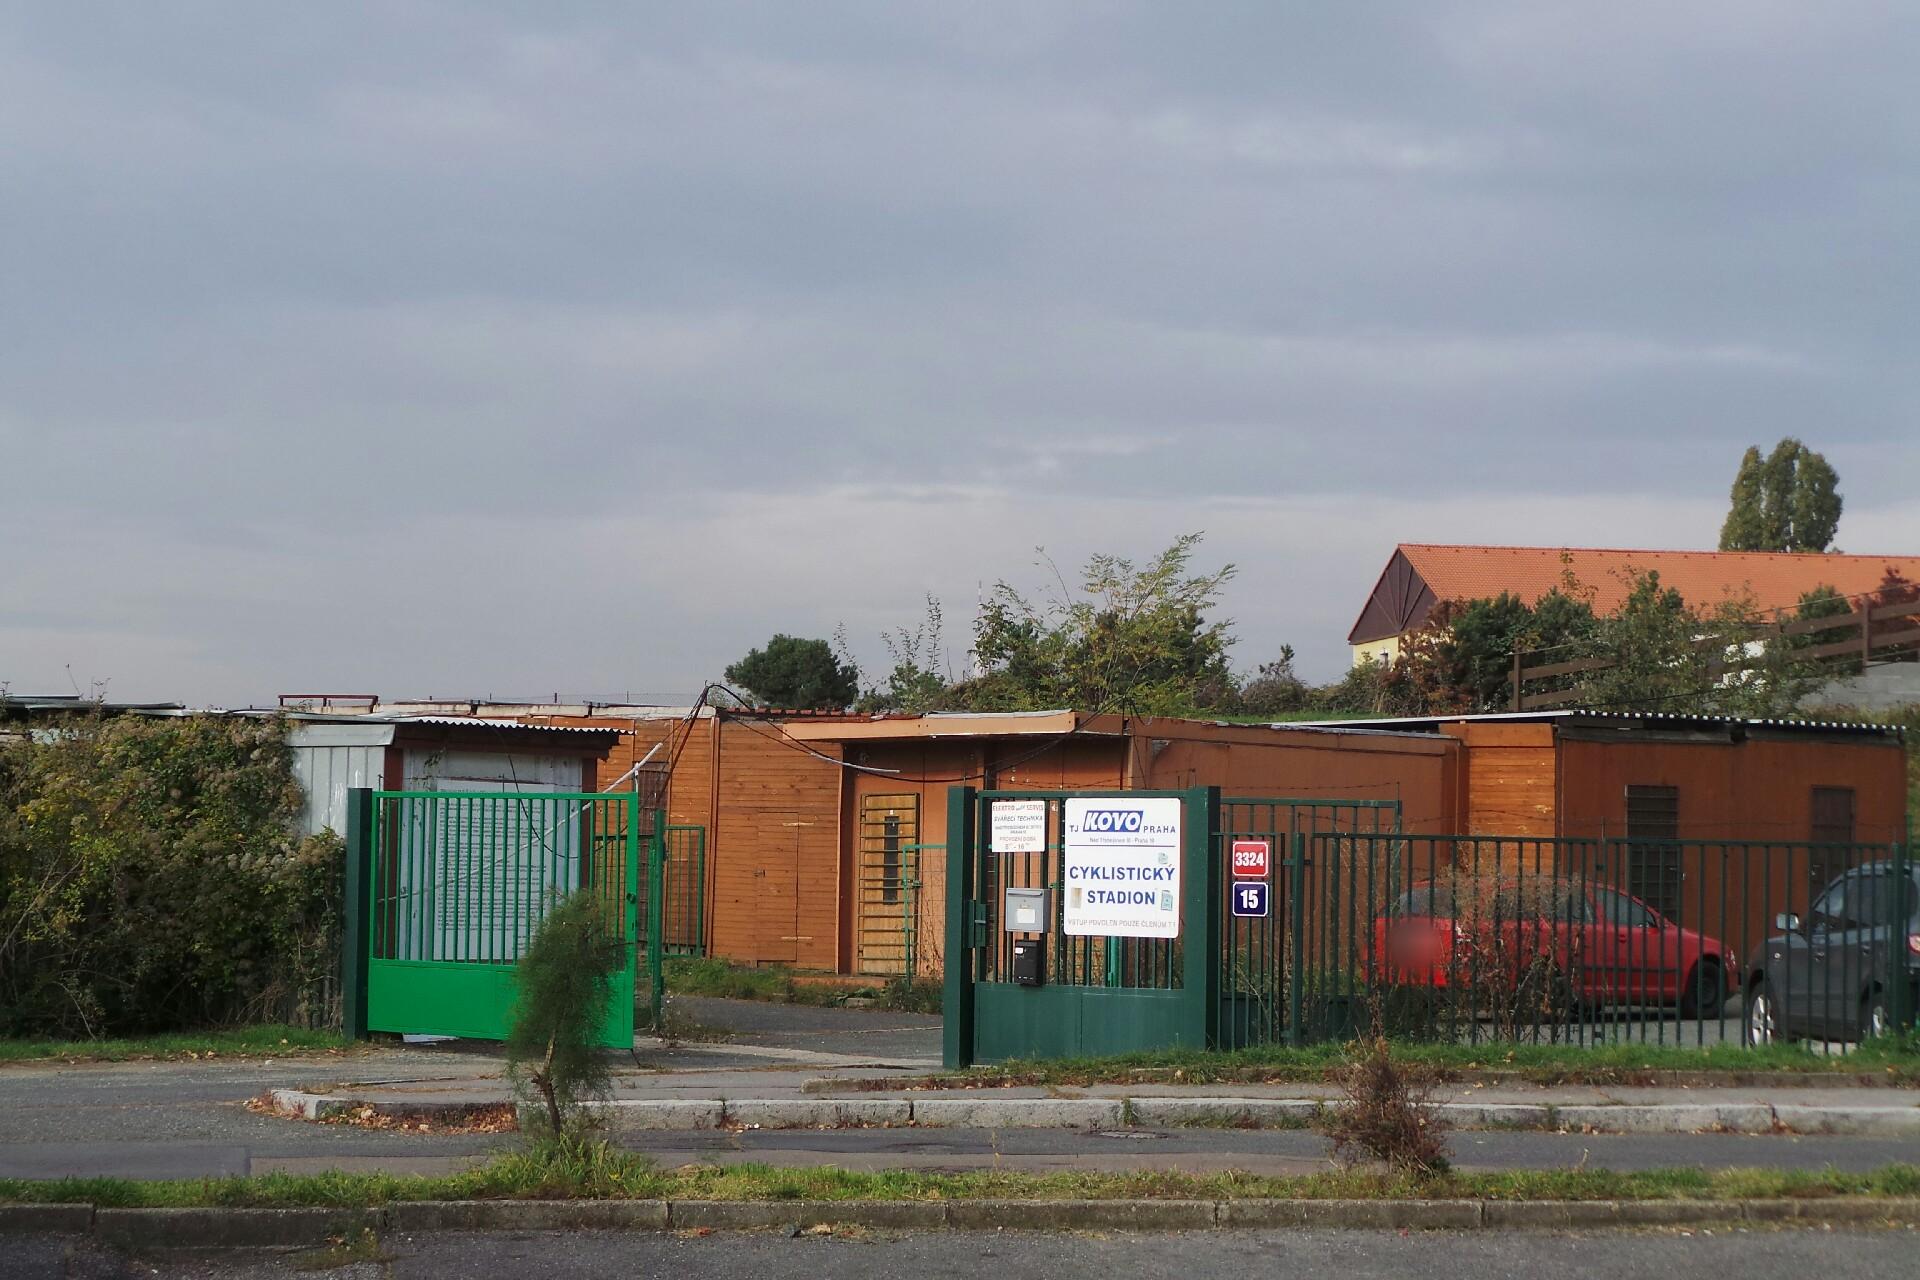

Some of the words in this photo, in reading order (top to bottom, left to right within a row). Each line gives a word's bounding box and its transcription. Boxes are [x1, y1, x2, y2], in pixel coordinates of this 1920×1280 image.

[1069, 824, 1079, 833] TJ
[1083, 811, 1141, 831] KOVO
[1143, 825, 1176, 834] PRAHA
[1235, 852, 1265, 867] 3324
[1069, 864, 1175, 881] CYKLISTICKÝ
[1087, 890, 1155, 905] STADION
[1240, 889, 1259, 909] 15
